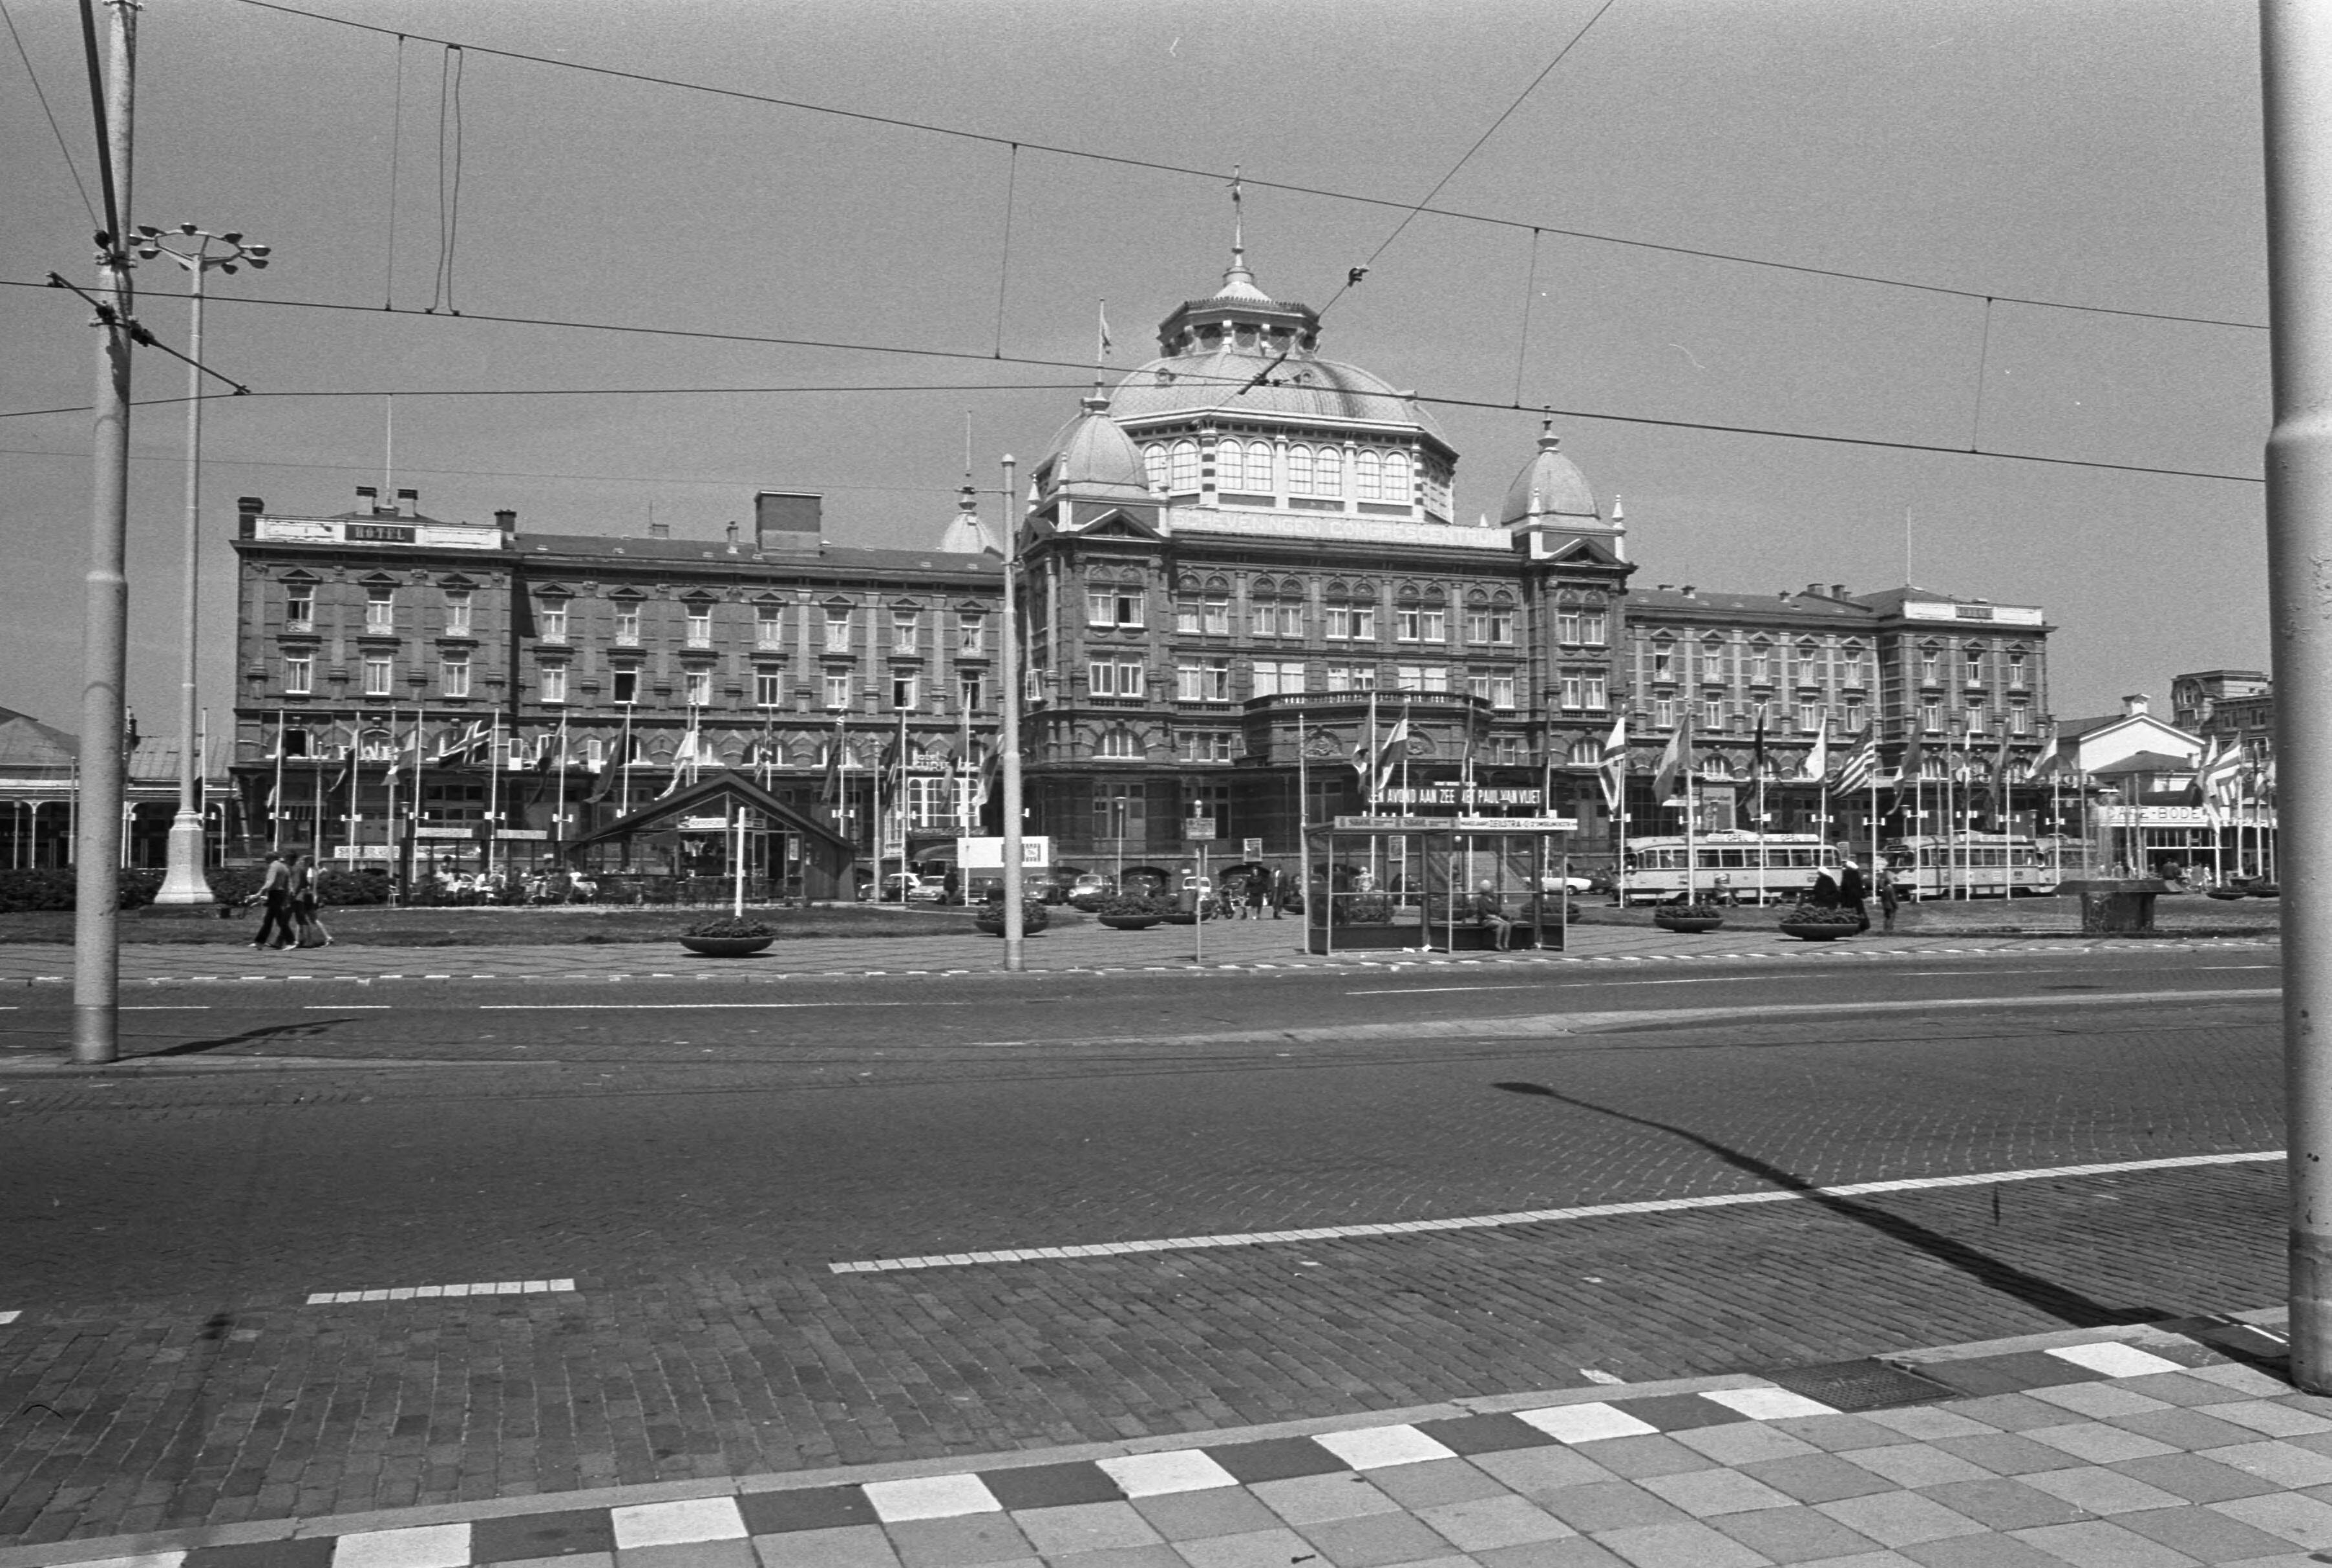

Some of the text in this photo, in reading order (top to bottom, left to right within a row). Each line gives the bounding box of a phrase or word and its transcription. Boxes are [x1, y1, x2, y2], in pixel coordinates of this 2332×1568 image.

[355, 527, 405, 540] HOTEL
[1419, 789, 1437, 803] AAN
[1439, 789, 1455, 803] ZEE
[1478, 790, 1499, 804] PAUL
